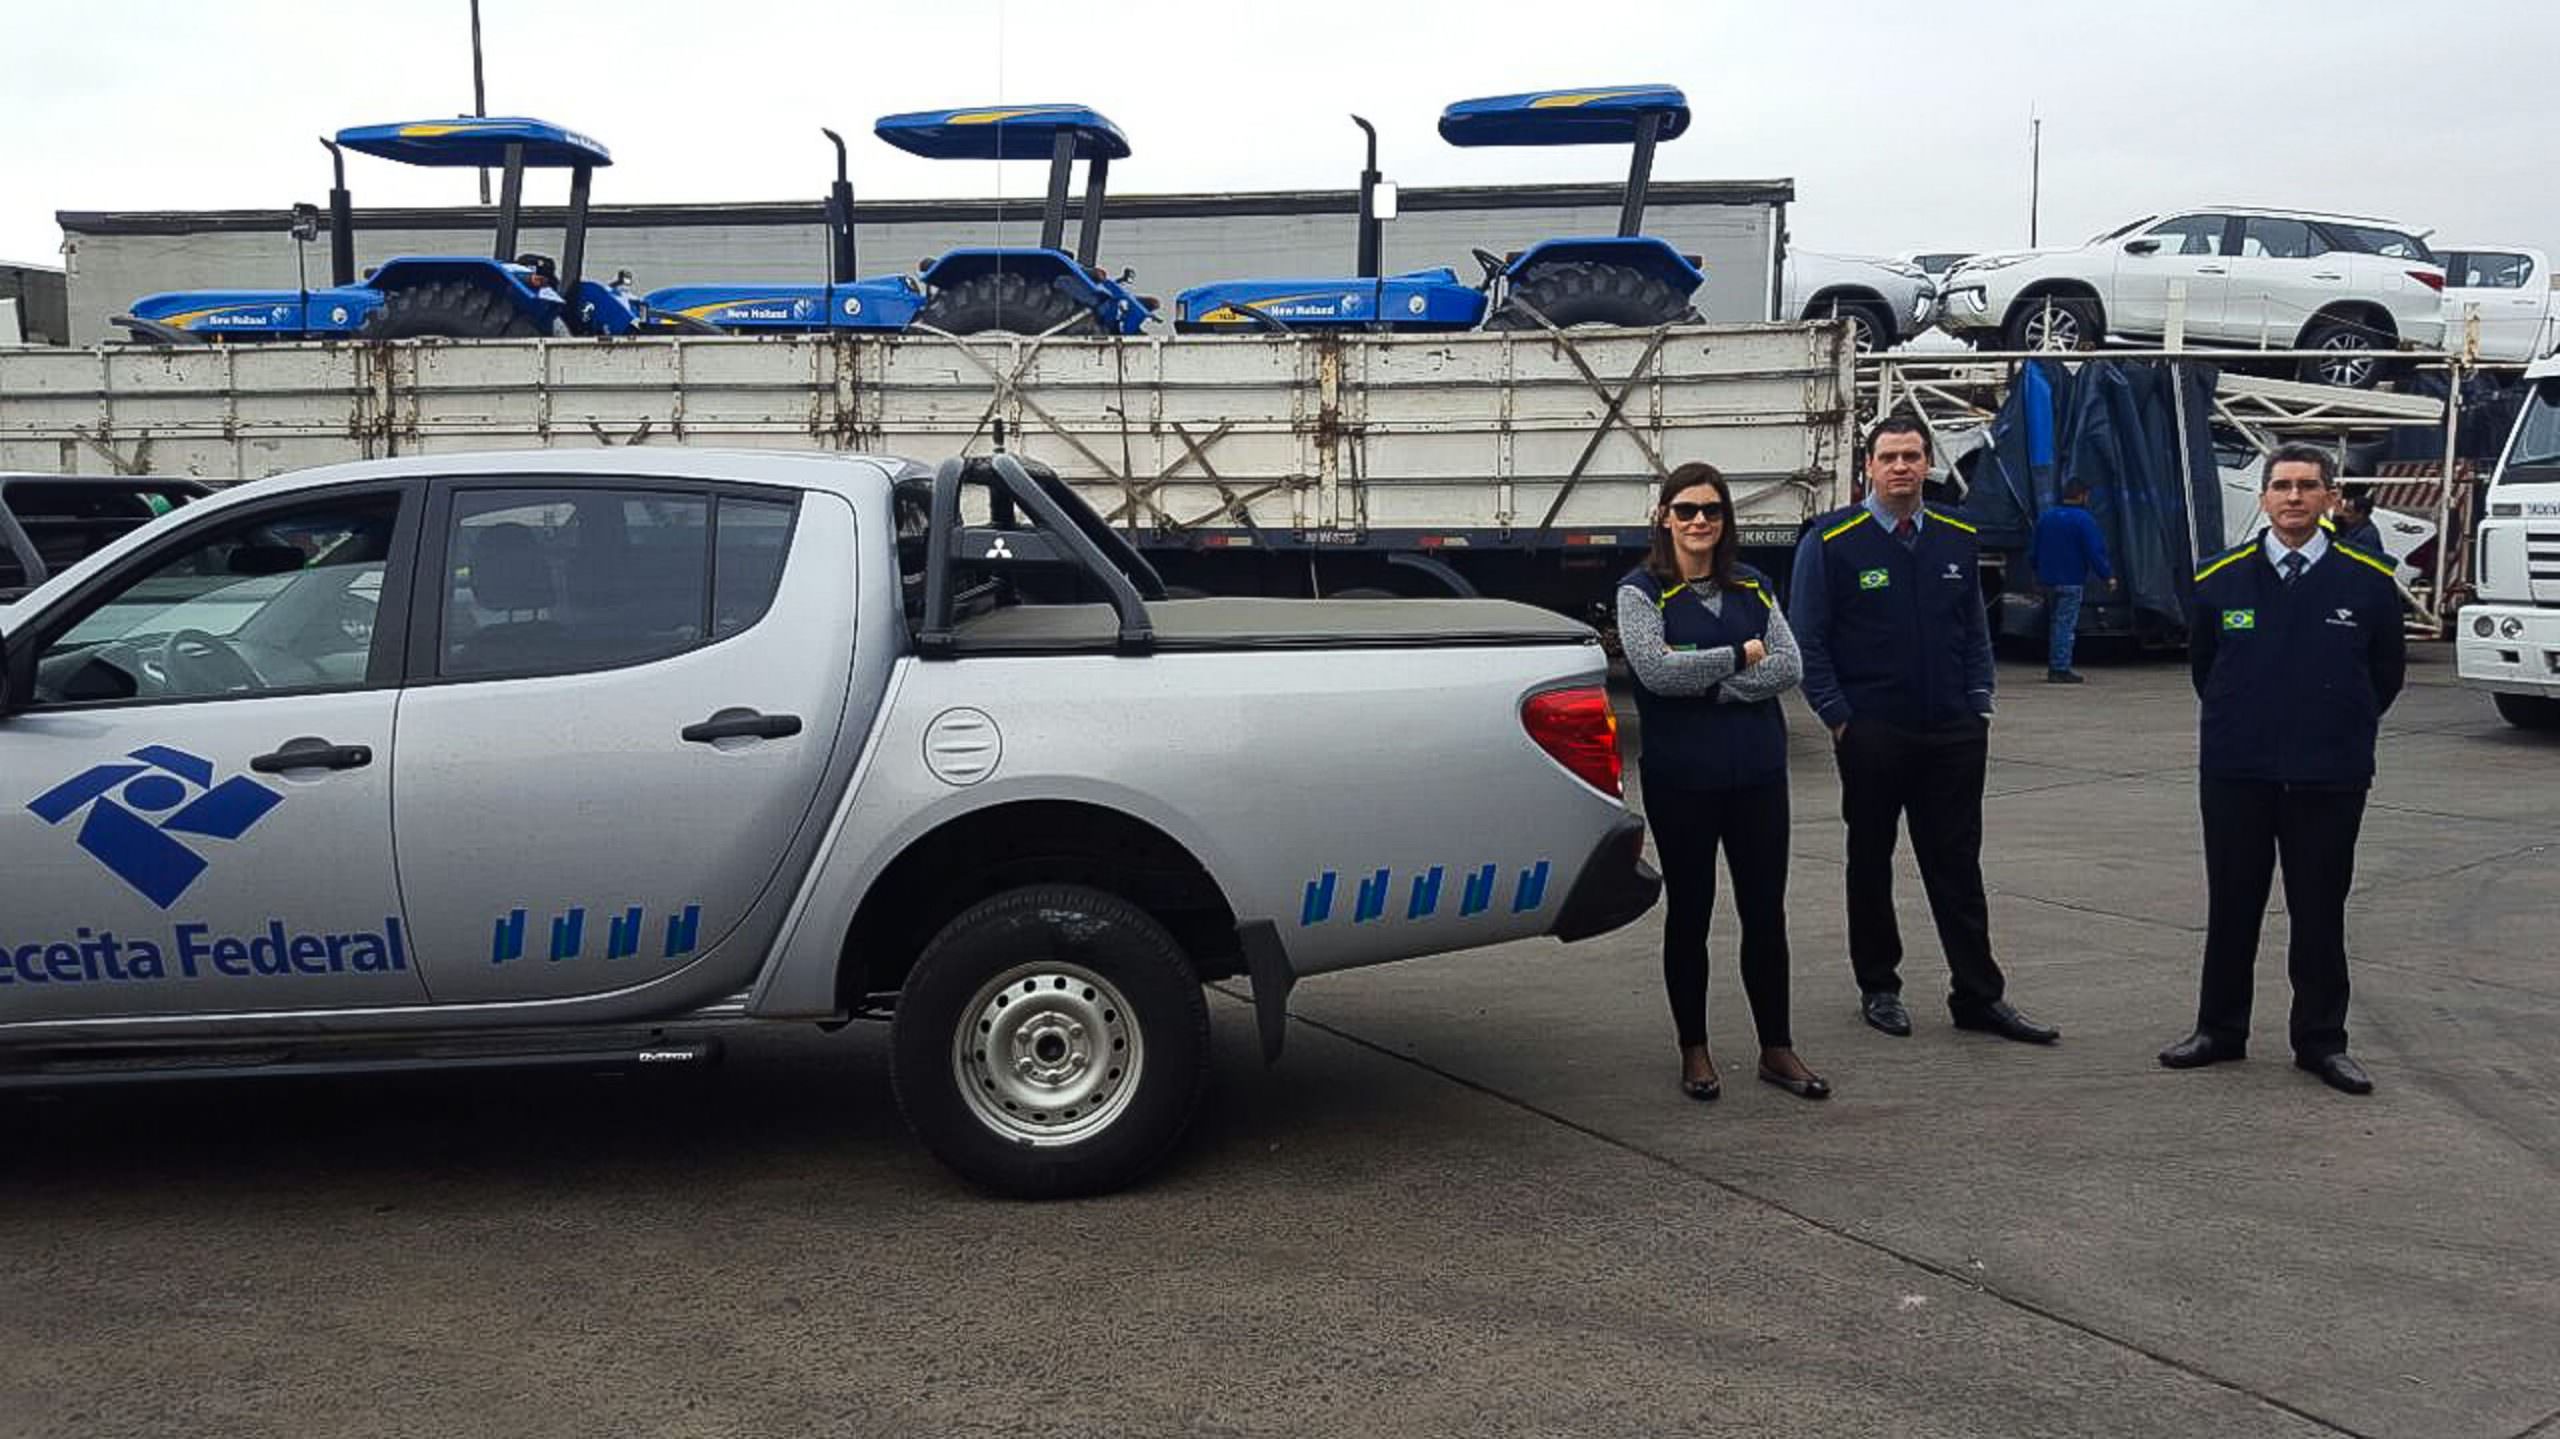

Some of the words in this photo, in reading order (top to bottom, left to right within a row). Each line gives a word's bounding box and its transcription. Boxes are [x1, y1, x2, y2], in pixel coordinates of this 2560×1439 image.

[727, 308, 749, 319] New
[751, 308, 788, 319] Holland
[1271, 305, 1293, 316] New
[1295, 304, 1335, 315] Holland
[209, 315, 230, 325] New
[232, 314, 267, 325] Holland
[174, 916, 407, 978] Federal
